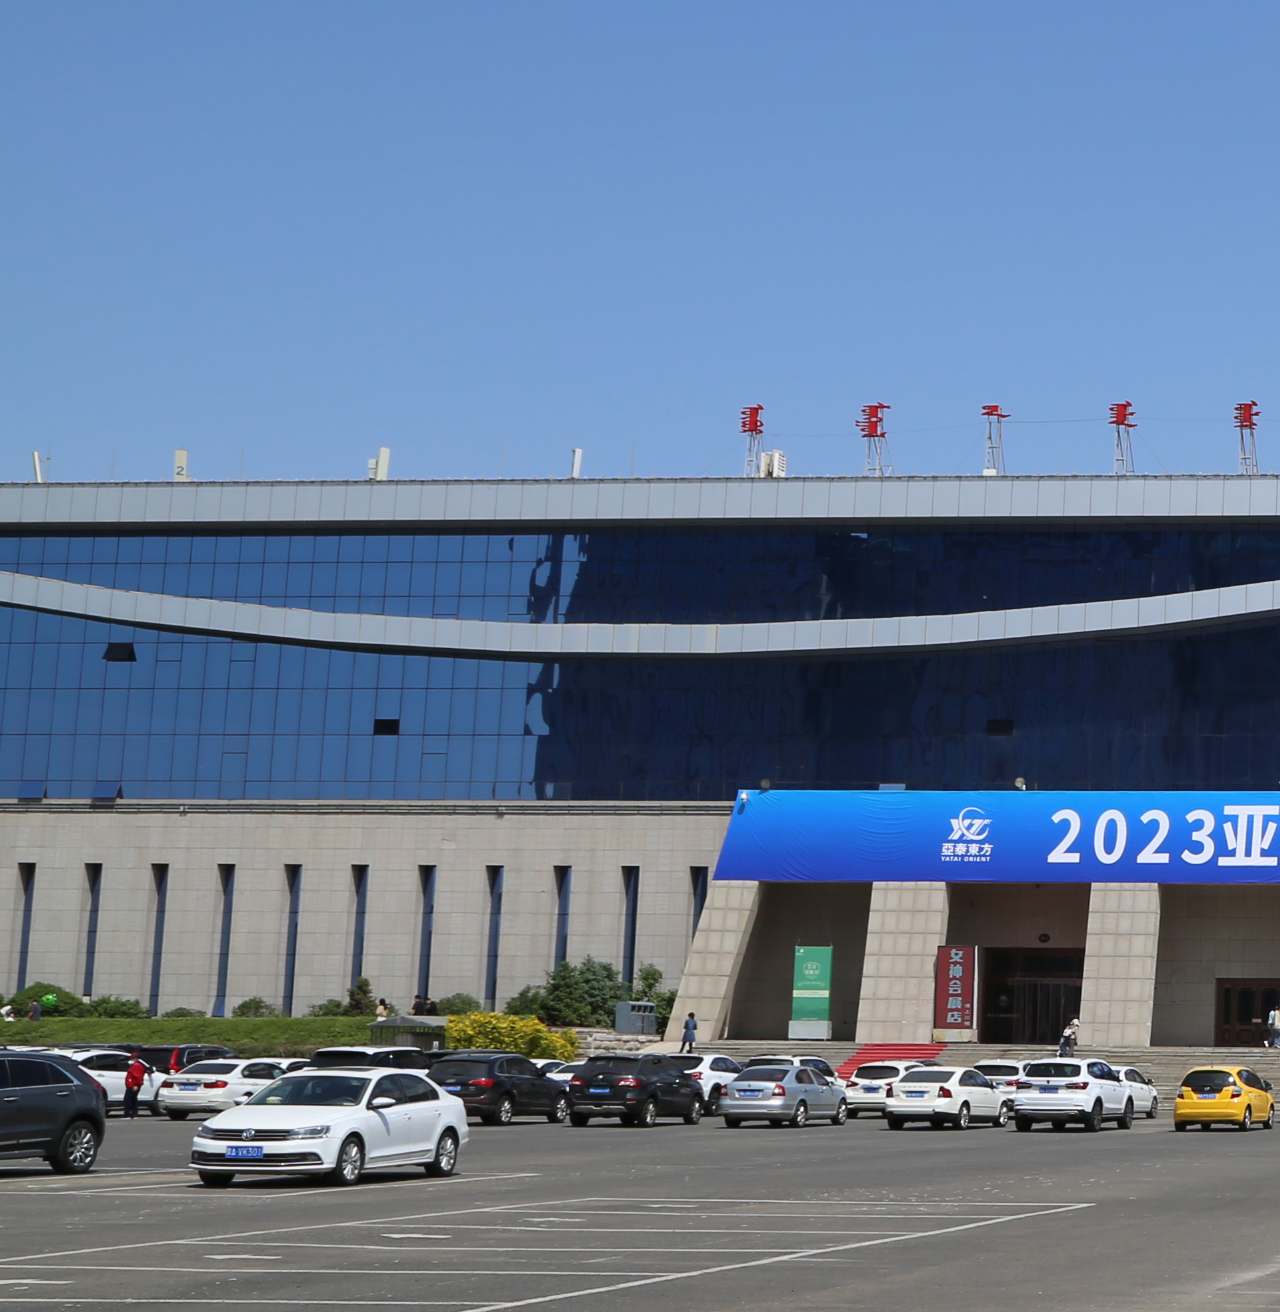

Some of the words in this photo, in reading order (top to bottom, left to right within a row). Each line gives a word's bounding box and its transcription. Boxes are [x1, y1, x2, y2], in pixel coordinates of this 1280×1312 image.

[941, 842, 994, 856] 亞泰東方
[946, 949, 964, 1023] 女神会展店
